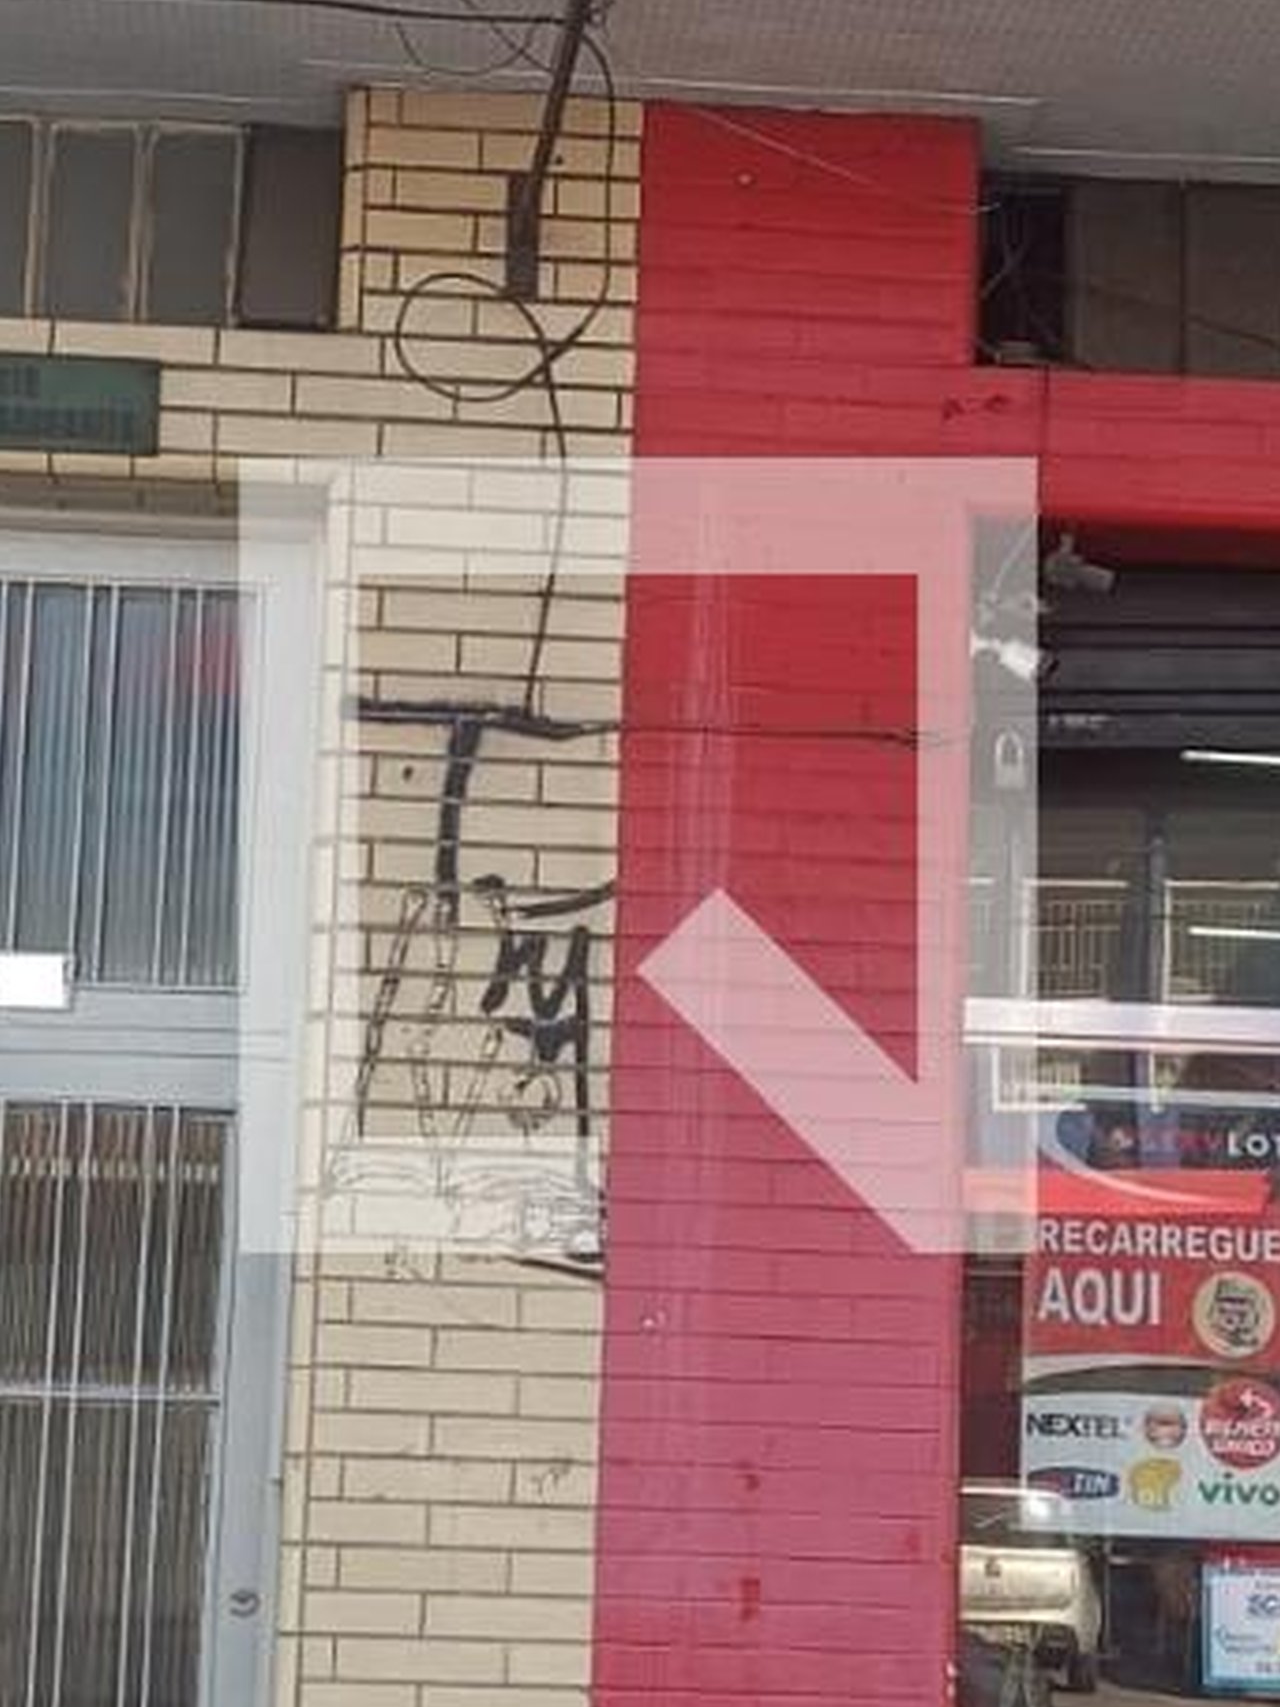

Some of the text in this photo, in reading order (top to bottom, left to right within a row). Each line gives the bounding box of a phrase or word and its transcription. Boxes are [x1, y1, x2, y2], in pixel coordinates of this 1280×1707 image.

[1037, 1268, 1161, 1326] AQUI
[1026, 1413, 1122, 1438] NEXTEL
[1072, 1474, 1113, 1494] TIM
